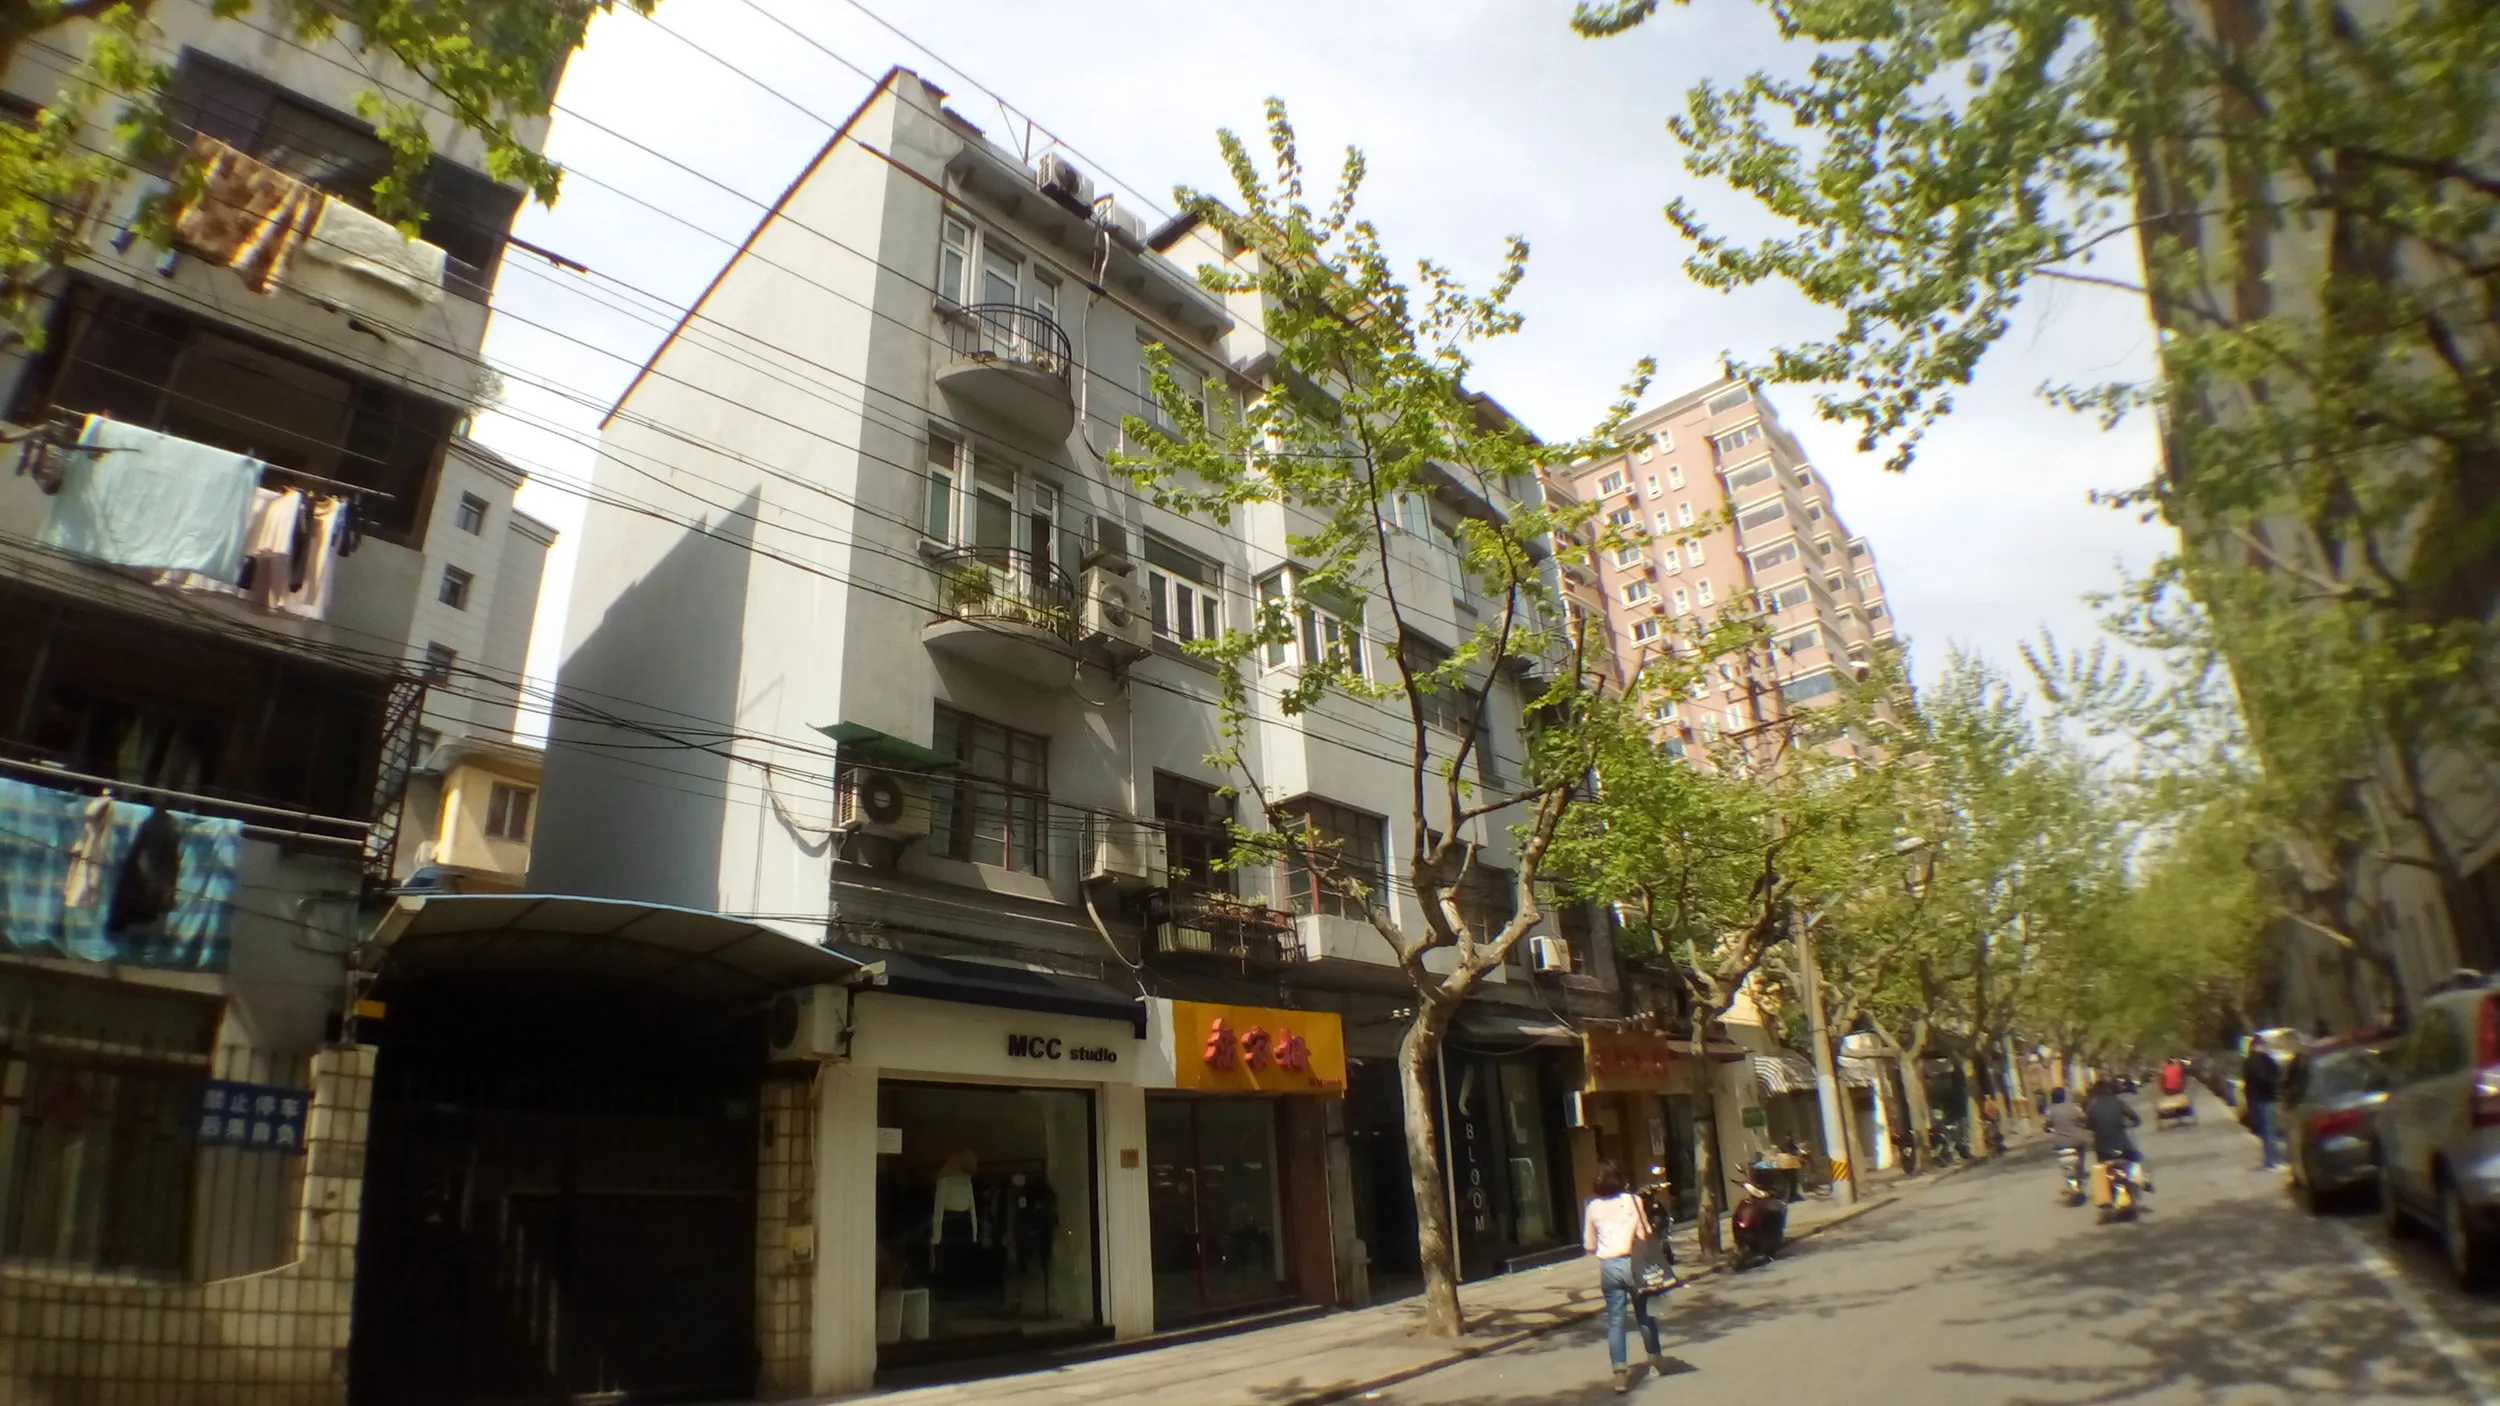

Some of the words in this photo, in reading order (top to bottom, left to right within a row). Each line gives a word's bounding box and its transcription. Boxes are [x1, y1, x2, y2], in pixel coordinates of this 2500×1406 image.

[1008, 1034, 1062, 1060] MCC
[1069, 1046, 1118, 1063] studio
[204, 1089, 300, 1118] 禁止停车
[199, 1115, 296, 1145] 后果自负
[1465, 1122, 1485, 1232] BLOOM
